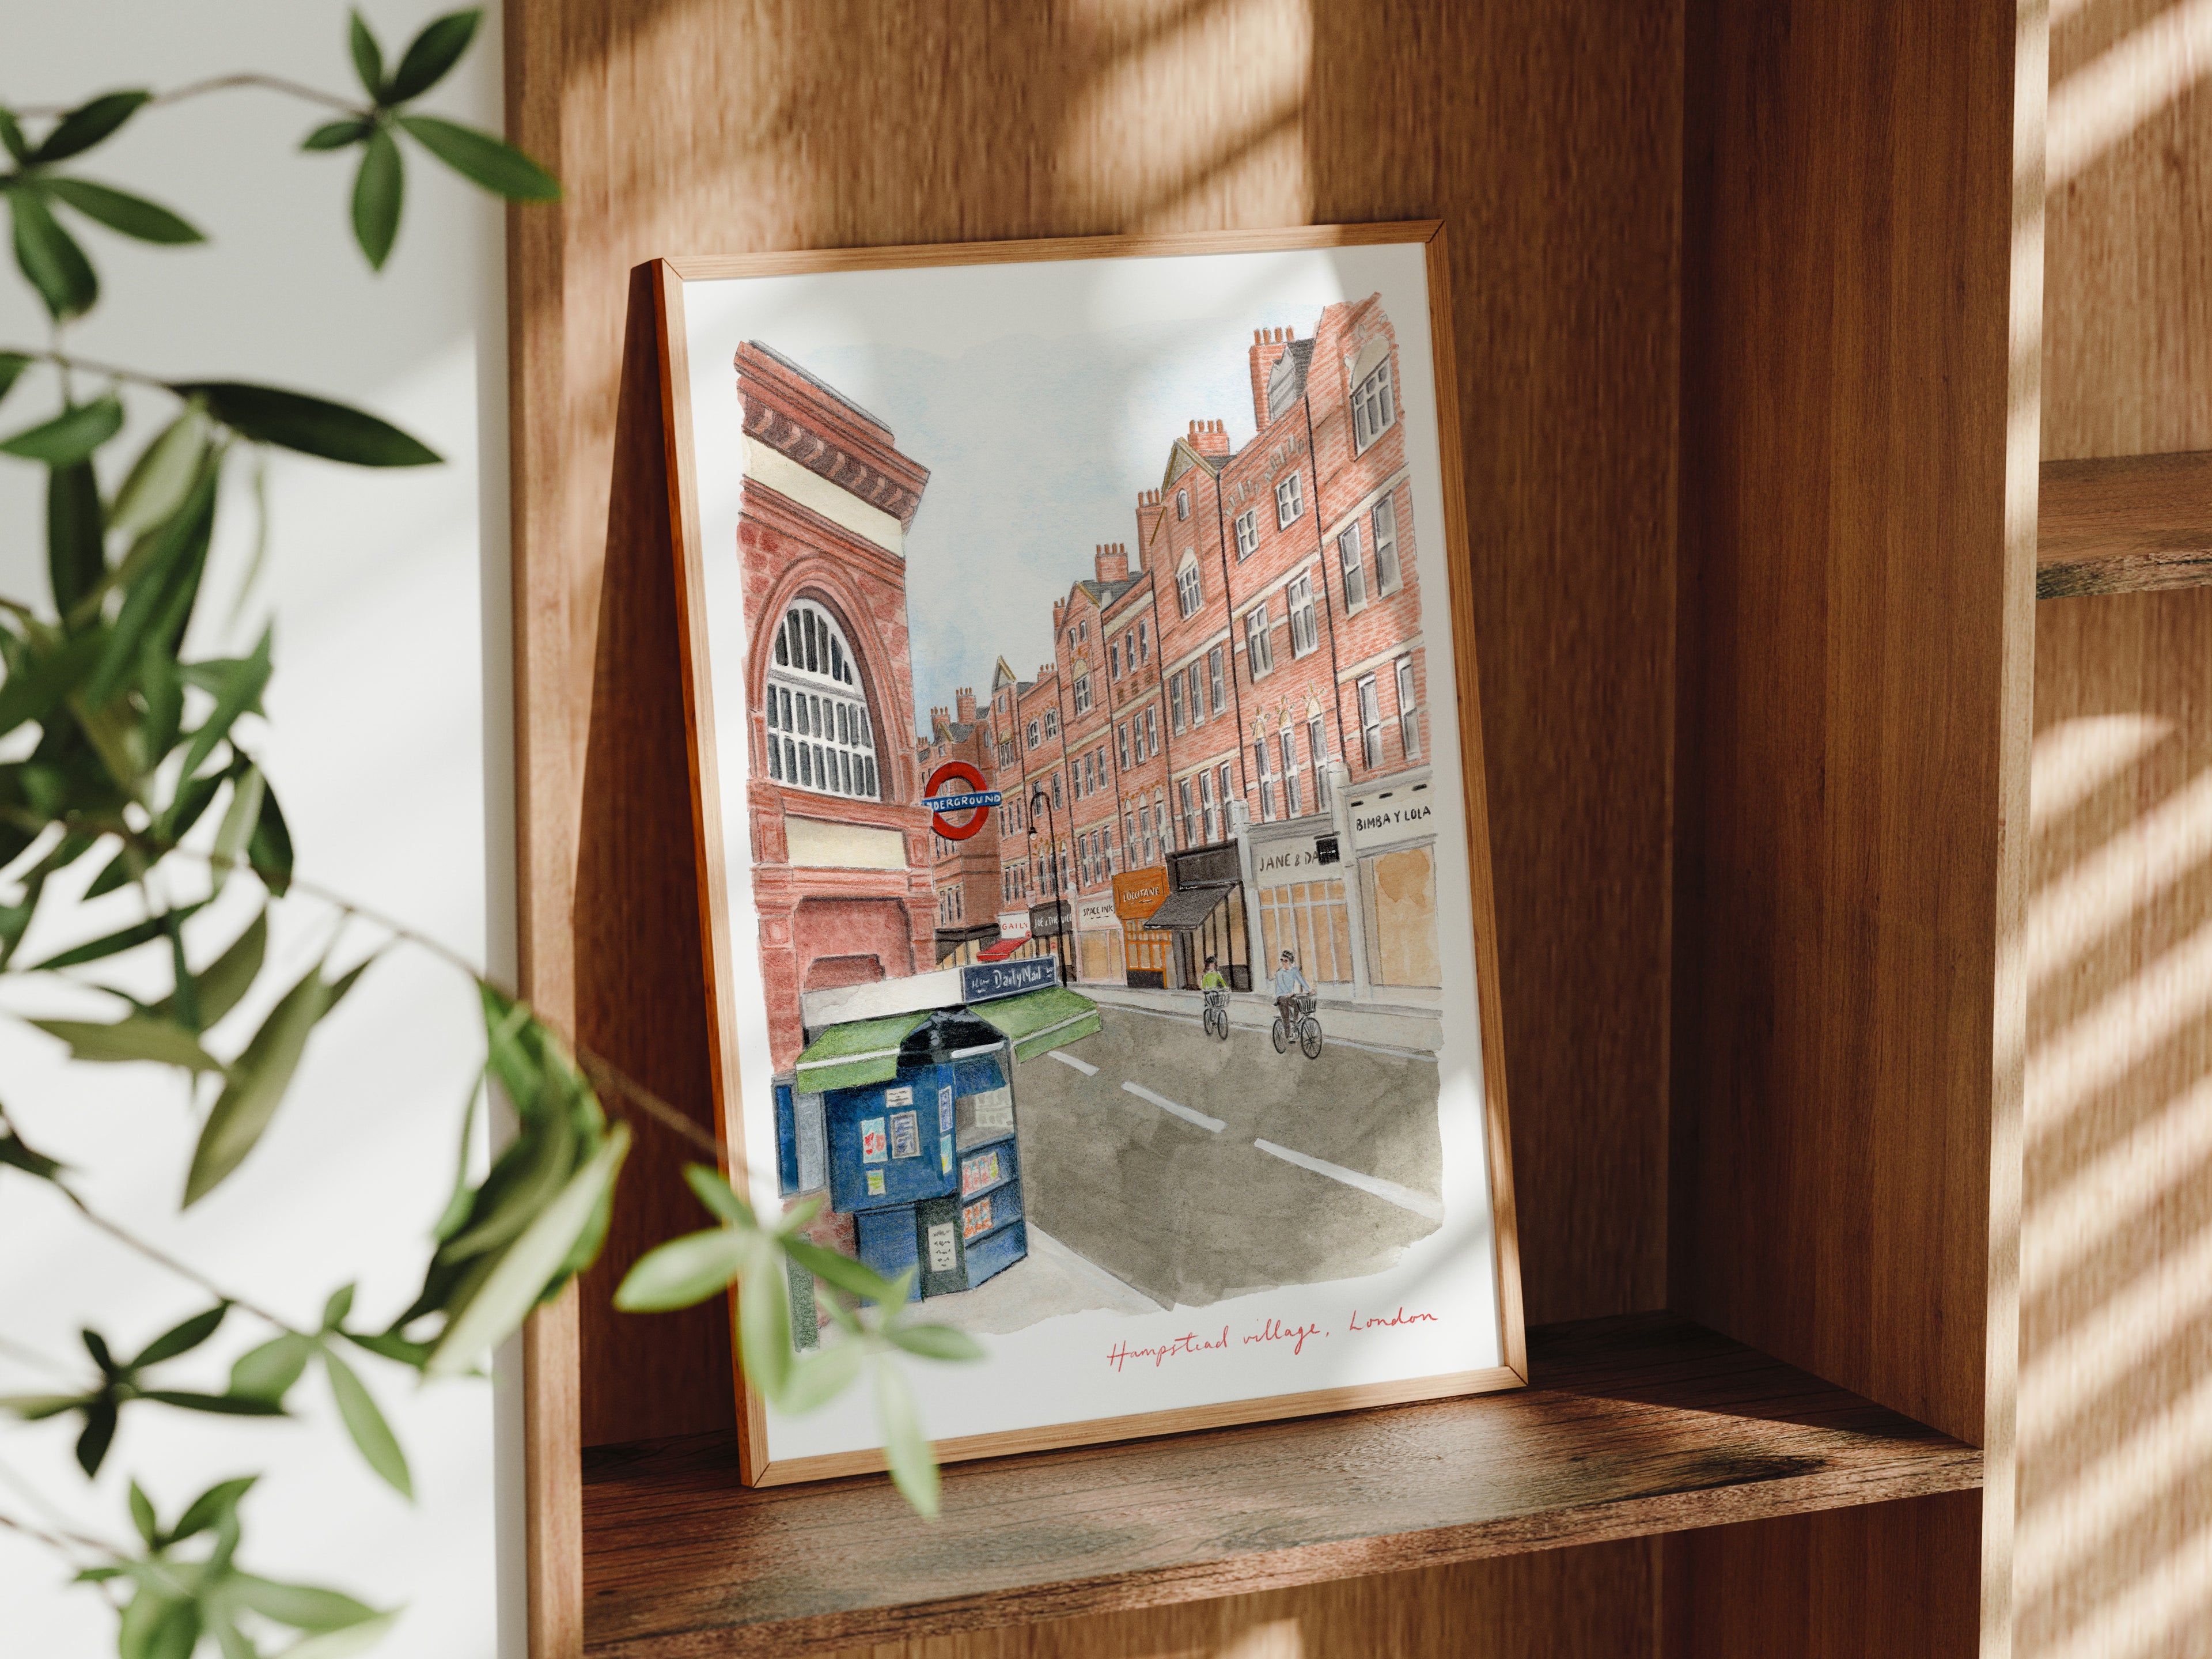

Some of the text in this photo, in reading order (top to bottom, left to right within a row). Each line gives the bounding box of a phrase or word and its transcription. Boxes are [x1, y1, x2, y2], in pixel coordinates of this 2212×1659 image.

[1356, 805, 1431, 831] BIMBA Y LOLA
[1259, 853, 1291, 872] JANE
[1294, 854, 1300, 867] &
[1083, 904, 1113, 916] SPACE INK
[1034, 917, 1044, 929] JOE
[1048, 916, 1059, 926] THE
[1060, 914, 1072, 924] UICE
[1106, 1306, 1439, 1373] Hampstead village, London
